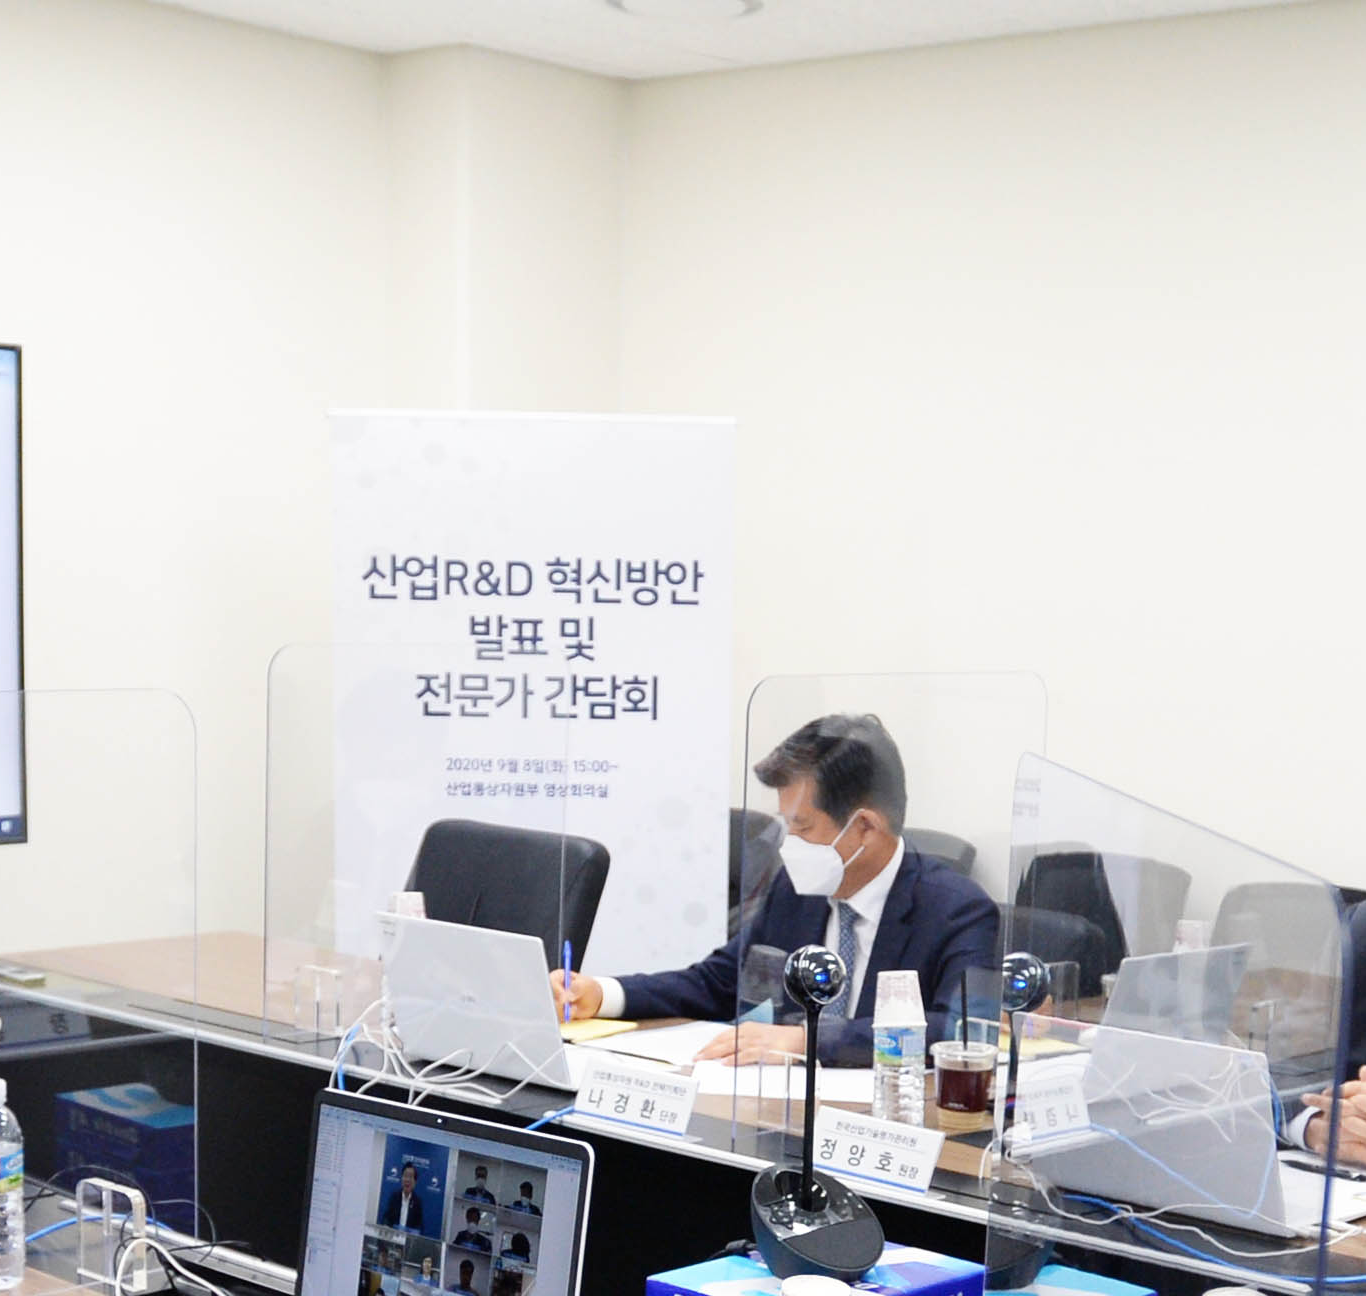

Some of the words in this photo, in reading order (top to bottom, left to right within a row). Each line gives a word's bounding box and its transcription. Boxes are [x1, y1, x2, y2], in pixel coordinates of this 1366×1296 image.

[362, 554, 534, 601] 산업R&D
[545, 557, 705, 606] 혁신방안
[469, 614, 549, 661] 발표
[559, 616, 595, 661] 및
[415, 672, 534, 718] 전문가
[544, 674, 659, 720] 간담회
[445, 757, 493, 772] 2020년
[496, 758, 519, 773] 9월
[445, 782, 539, 796] 산업통상자원부
[543, 783, 609, 798] 영상회의실
